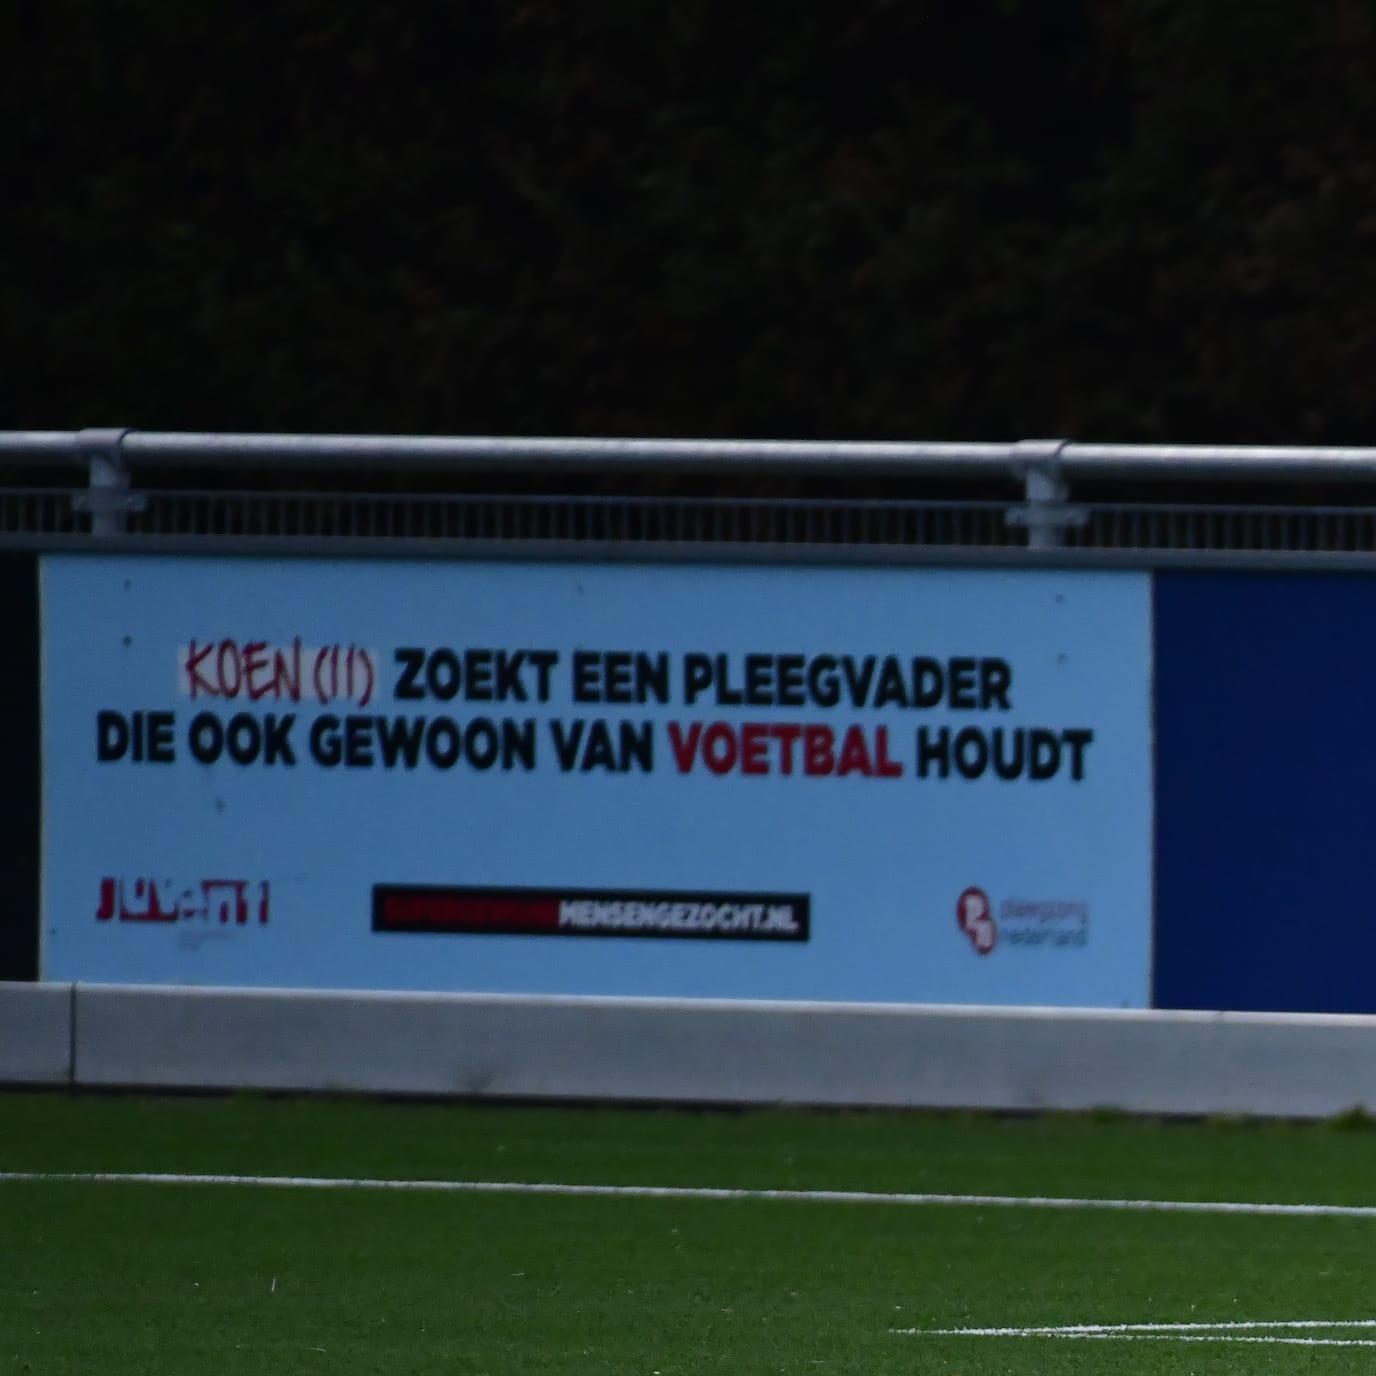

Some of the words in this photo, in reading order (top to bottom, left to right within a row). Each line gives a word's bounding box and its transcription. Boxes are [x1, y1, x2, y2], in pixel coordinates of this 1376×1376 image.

[186, 637, 302, 701] KOEN
[394, 647, 559, 701] ZOEKT
[572, 651, 669, 703] EEN
[683, 653, 1012, 711] PLEEGVADER
[97, 711, 176, 762] DIE
[188, 712, 297, 765] OOK
[310, 715, 535, 770] GEWOON
[551, 719, 653, 773] VAN
[668, 721, 903, 777] VOETBAL
[917, 725, 1094, 781] HOUDT
